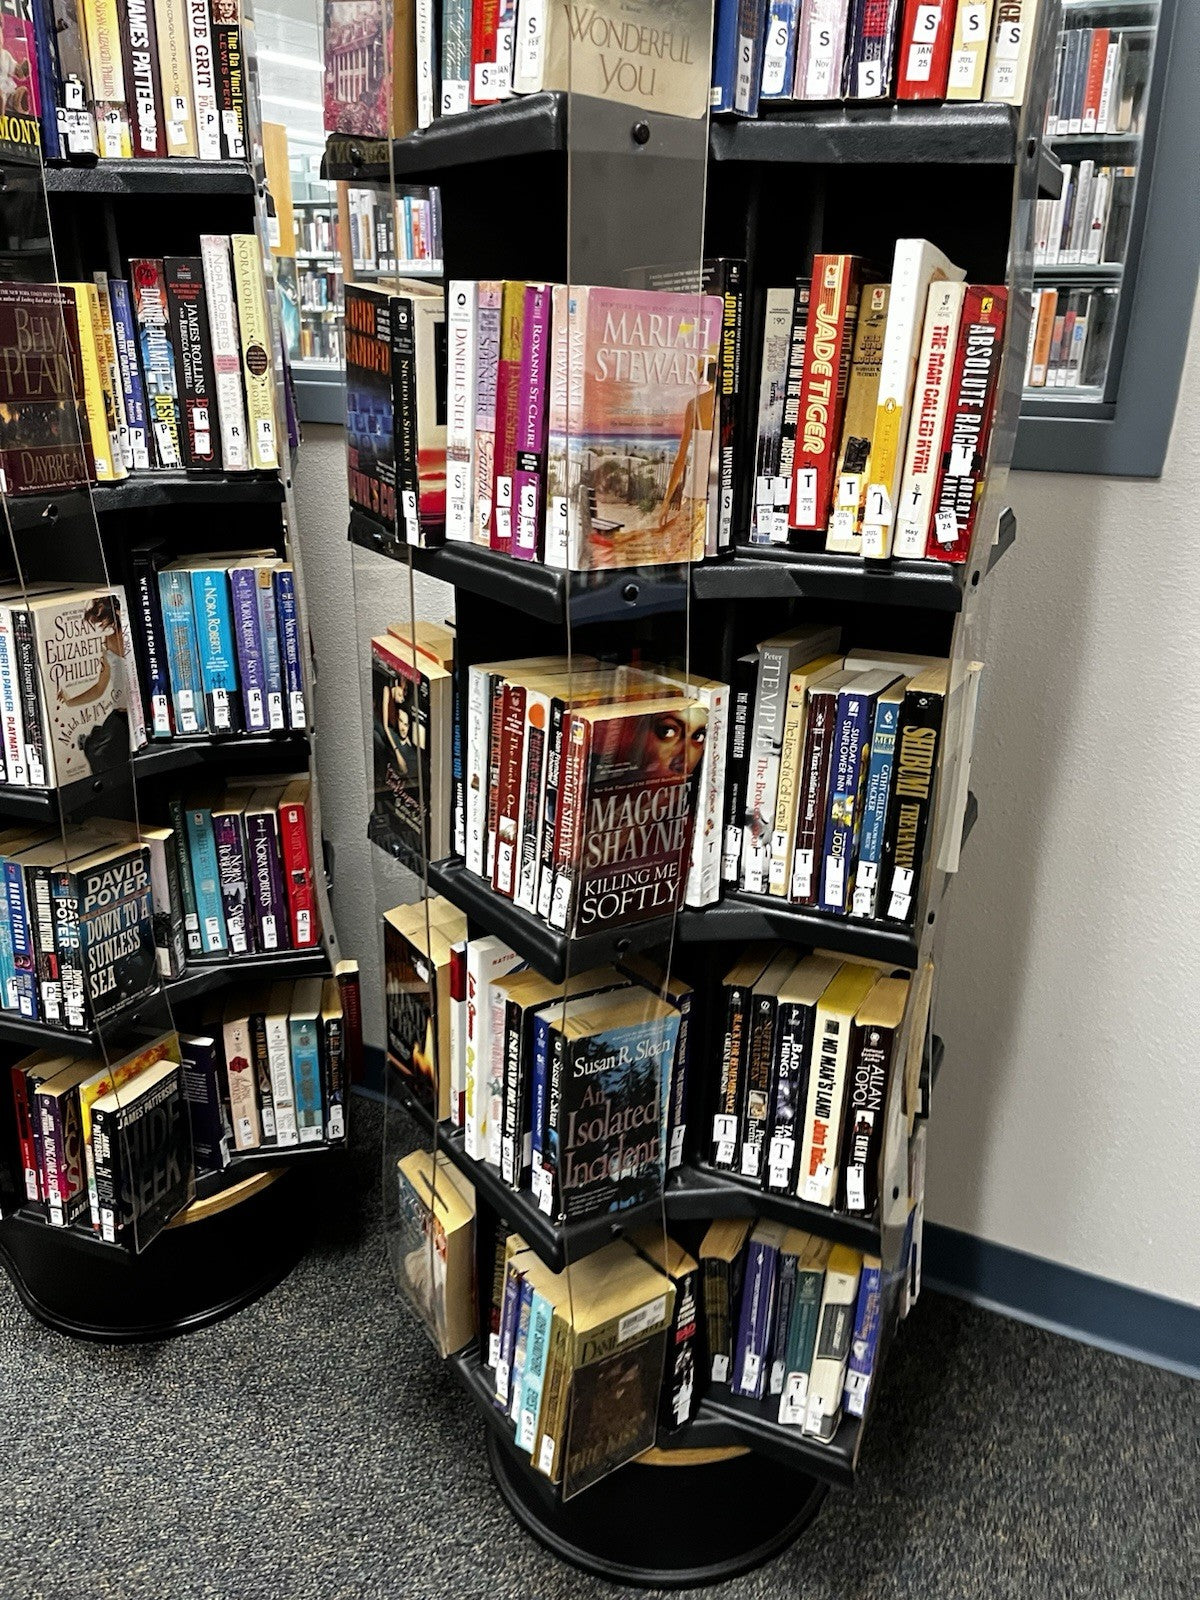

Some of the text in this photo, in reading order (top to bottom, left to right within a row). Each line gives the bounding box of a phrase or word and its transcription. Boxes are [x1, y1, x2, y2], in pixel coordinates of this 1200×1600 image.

[192, 1, 208, 38] RUE
[528, 17, 537, 33] S
[776, 28, 787, 45] S
[820, 31, 830, 46] S
[925, 15, 936, 30] S
[969, 15, 979, 30] S
[1009, 28, 1020, 43] S
[195, 45, 212, 88] GRIT
[219, 33, 229, 75] LEWIS
[228, 31, 243, 97] The Da Vinci
[564, 4, 693, 96] WONDERFUL YOU
[743, 47, 750, 62] S
[865, 71, 875, 86] S
[213, 253, 231, 349] NORA ROBERTS
[238, 239, 255, 334] NORA ROBERTS
[14, 308, 75, 352] BELVA
[140, 288, 171, 375] DANIEL PALMER
[184, 302, 205, 394] JAMES ROLLINS
[603, 311, 712, 351] MARIAH
[722, 292, 737, 395] JOHN SANDFORD
[930, 325, 950, 350] THE
[1, 347, 80, 396] PLAIN
[116, 322, 132, 394] COUNTRY GRAVEYARD
[180, 319, 195, 389] REBECCA CANTRELL
[595, 347, 716, 386] STEWART
[925, 352, 946, 386] MAN
[957, 324, 996, 407] ABSOLUTE
[454, 328, 468, 429] DANIELLE STEEL
[477, 338, 488, 412] SPENCER
[526, 324, 542, 448] ROXANNE CLAIRE
[784, 325, 807, 425] THE MAN IN THE QUEUE
[802, 302, 840, 455] JADE TIGER
[400, 359, 412, 463] NICHOLAS SPARKS
[917, 388, 940, 438] CALLED
[477, 437, 494, 501] Gamble
[765, 477, 774, 490] T
[804, 475, 813, 488] T
[846, 482, 855, 495] T
[503, 484, 510, 497] S
[527, 494, 534, 507] S
[912, 492, 922, 505] T
[955, 475, 975, 519] ROBERT
[938, 512, 952, 520] Dec
[54, 614, 96, 643] SUSAN
[139, 577, 159, 680] WE'RE NOT FROM HERE
[203, 587, 222, 655] NORA ROBERTS
[240, 601, 255, 652] NORA ROBERTS
[284, 618, 298, 665] NORA ROBERTS
[45, 636, 109, 666] ELIZABETH
[49, 655, 106, 691] PHILLIPS
[3, 678, 14, 712] PARKER
[735, 704, 747, 724] NIGHT
[756, 651, 782, 750] Peter TEMPLE
[6, 716, 19, 762] PLAYMATE!
[58, 718, 80, 747] Match
[554, 731, 563, 753] Susan
[848, 727, 860, 764] SUNDAY
[757, 758, 768, 777] The
[779, 720, 798, 797] The Lives Cell
[811, 752, 820, 771] Texas
[836, 720, 852, 792] SUNFLOWER INN
[895, 725, 937, 799] SHIBUMI
[591, 782, 692, 834] MAGGIE
[868, 773, 880, 812] THACKER
[875, 764, 890, 822] CATHY GILLEN
[543, 824, 555, 863] Falling
[586, 816, 689, 869] SHAYNE
[87, 859, 145, 895] DAVID
[219, 844, 233, 884] ROBERTS
[230, 854, 243, 883] NORA
[254, 837, 272, 906] NORA ROBERTS
[585, 869, 650, 897] KILLING
[654, 862, 679, 884] ME
[83, 872, 148, 913] POYER
[581, 878, 680, 924] SOFTLY
[8, 881, 26, 951] NANCY PICKARD
[55, 898, 80, 949] DAVID POYER
[86, 895, 150, 946] DOWN TO A
[39, 922, 54, 952] PATTERSON
[88, 926, 141, 973] SUNLESS
[90, 965, 117, 1000] SEA
[551, 1058, 563, 1087] Susan
[573, 1039, 671, 1078] Susan R. Sloan
[725, 1013, 743, 1114] BLACK REMEMBRANCE
[779, 1033, 794, 1078] THINGS
[790, 1043, 803, 1070] BAD
[581, 1085, 605, 1109] An
[815, 1037, 838, 1119] NO MAN'S LAND
[852, 1064, 871, 1109] TOPOL
[866, 1064, 885, 1111] ALLAN
[41, 1108, 50, 1136] PATTERSON
[117, 1109, 144, 1131] JAMES
[144, 1084, 178, 1114] PATTERSON
[564, 1098, 660, 1150] Isolated
[718, 1118, 733, 1135] T
[42, 1136, 56, 1172] ALONG CAME
[92, 1124, 104, 1164] PATTERSON
[101, 1132, 110, 1159] JAMES
[563, 1133, 661, 1190] Incident
[774, 1143, 790, 1159] T
[853, 1134, 869, 1164] ENEMY
